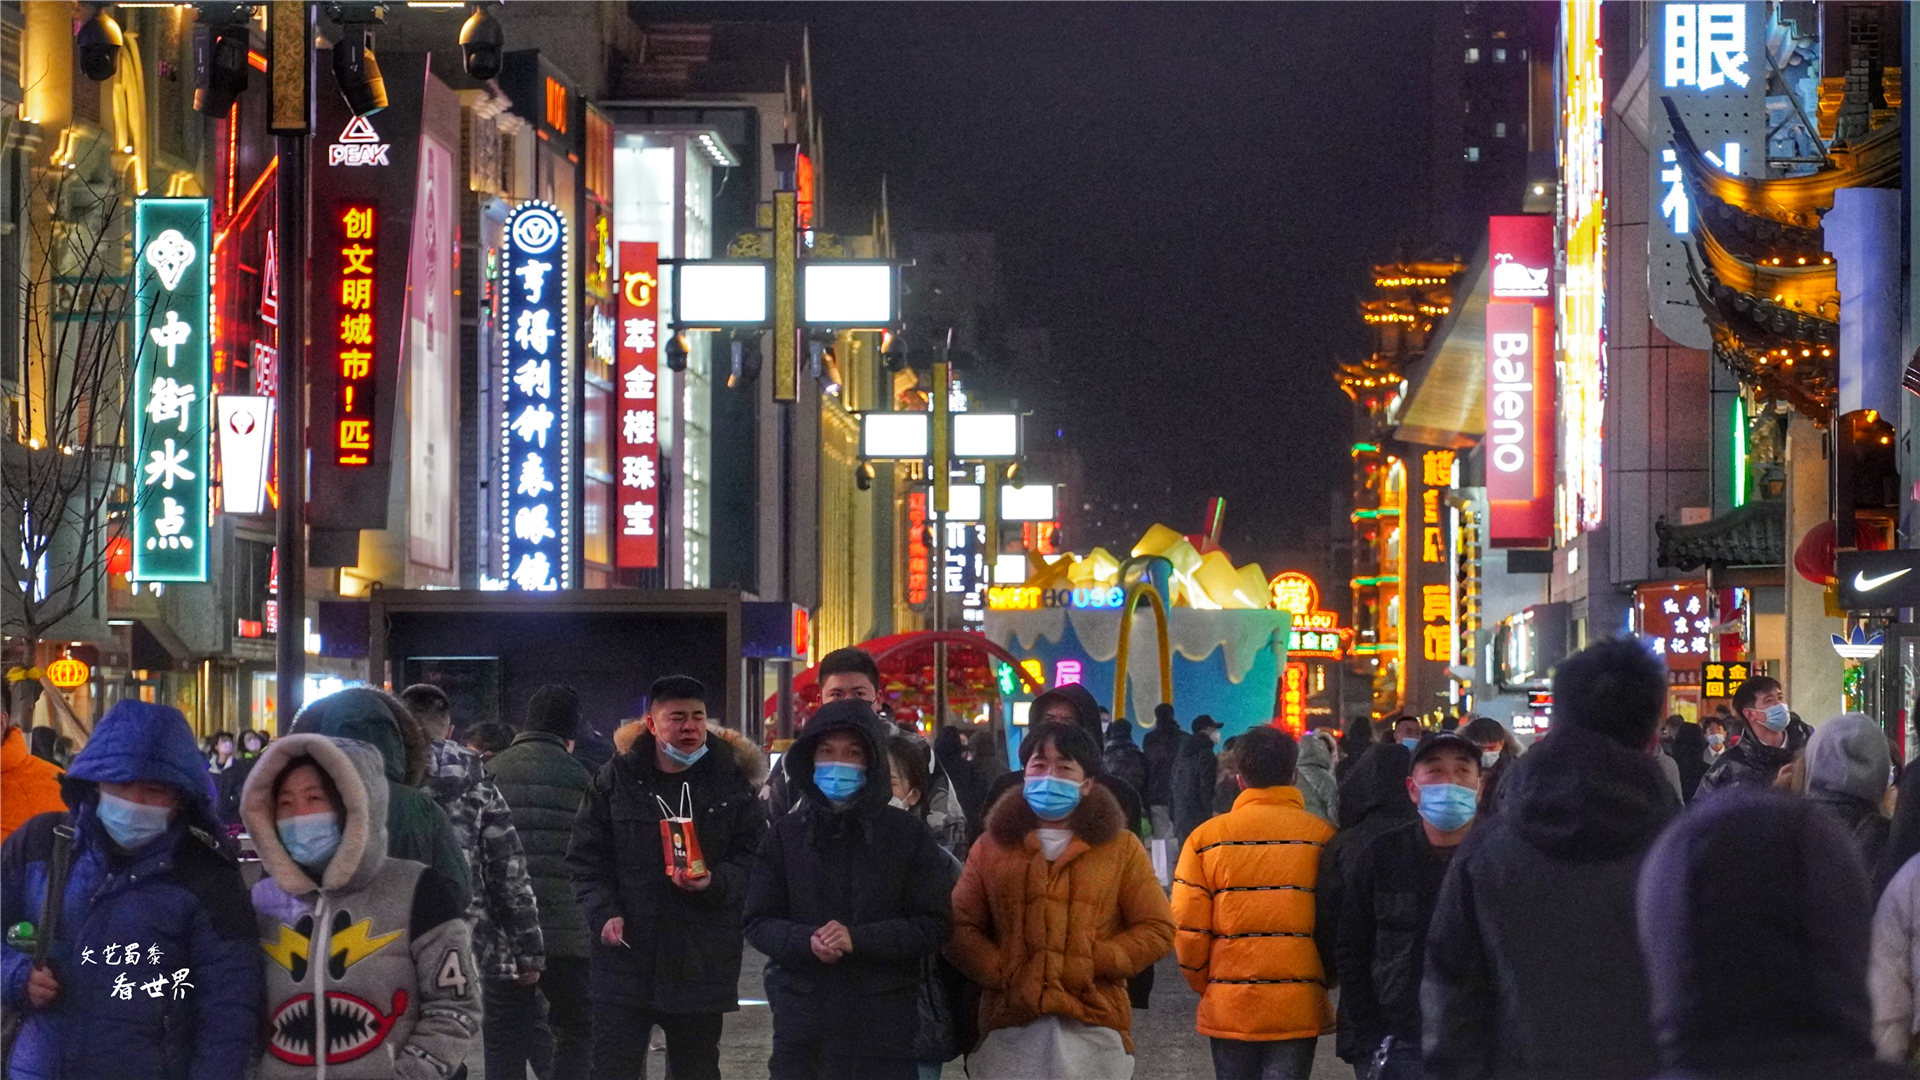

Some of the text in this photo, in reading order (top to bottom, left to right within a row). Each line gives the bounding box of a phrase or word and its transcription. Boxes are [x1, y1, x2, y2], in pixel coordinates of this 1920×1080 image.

[328, 143, 391, 167] PEAK
[1492, 332, 1532, 473] Baleno
[1706, 664, 1747, 680] 黄金
[437, 949, 467, 996] 4
